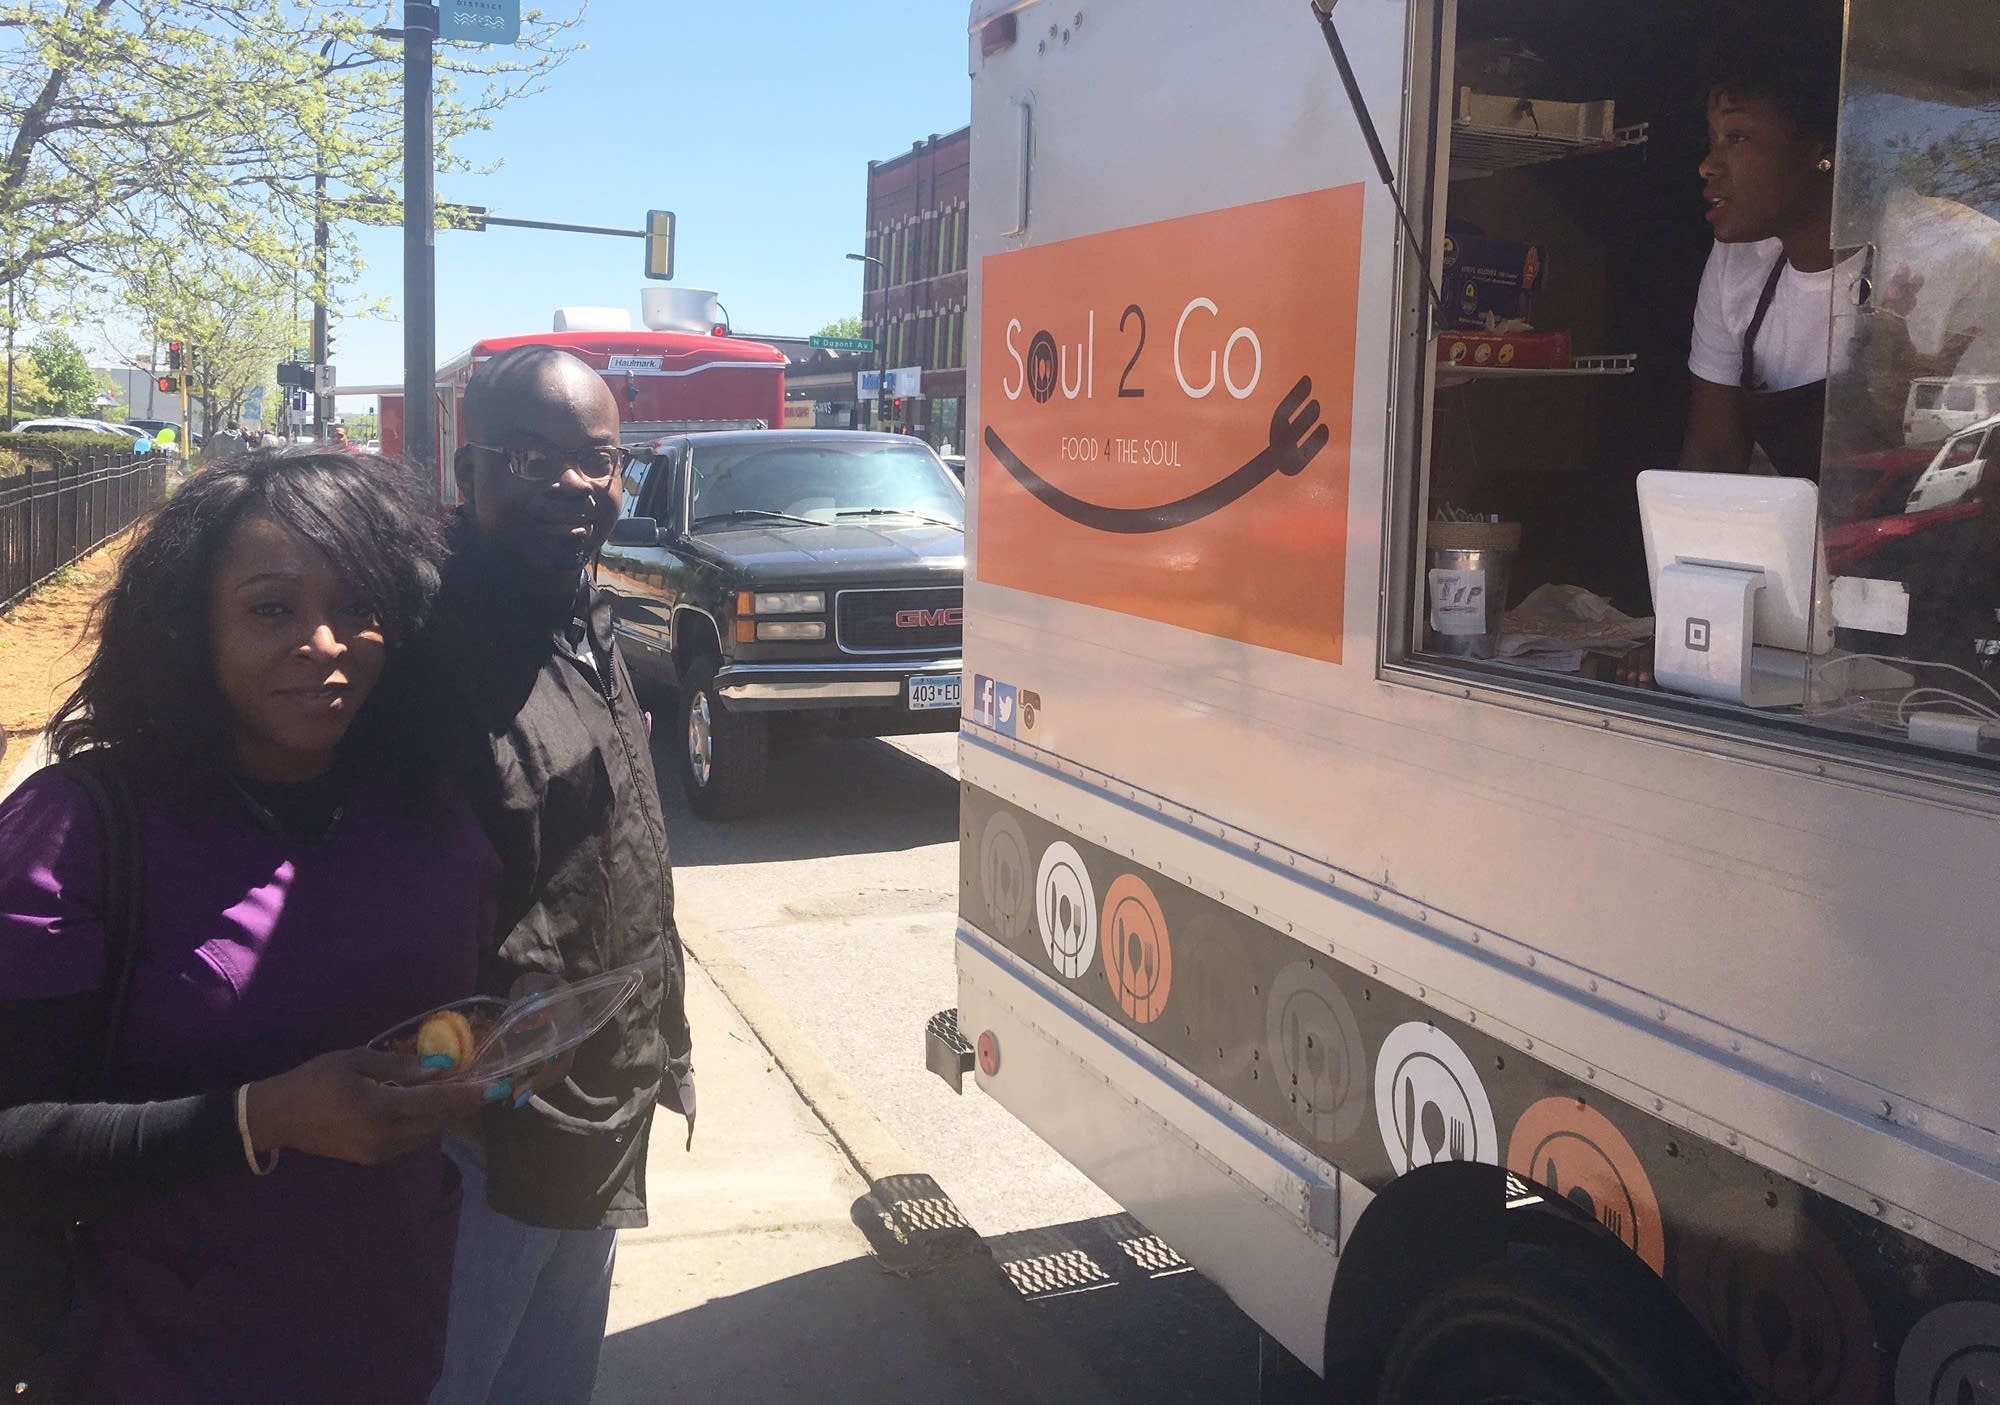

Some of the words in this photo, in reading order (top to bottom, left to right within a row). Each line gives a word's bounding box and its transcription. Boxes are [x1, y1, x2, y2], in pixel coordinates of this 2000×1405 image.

[456, 0, 502, 10] DISTRICT
[822, 340, 853, 348] Dupont
[1003, 310, 1094, 404] Soul
[1118, 304, 1146, 398] 2
[1173, 296, 1262, 400] Go
[615, 359, 655, 367] Haulmark
[1061, 436, 1098, 462] FOOD
[1103, 438, 1111, 462] 4
[1116, 438, 1138, 465] THE
[1143, 439, 1181, 467] SOUL
[895, 608, 963, 627] GMC
[912, 685, 935, 702] 403
